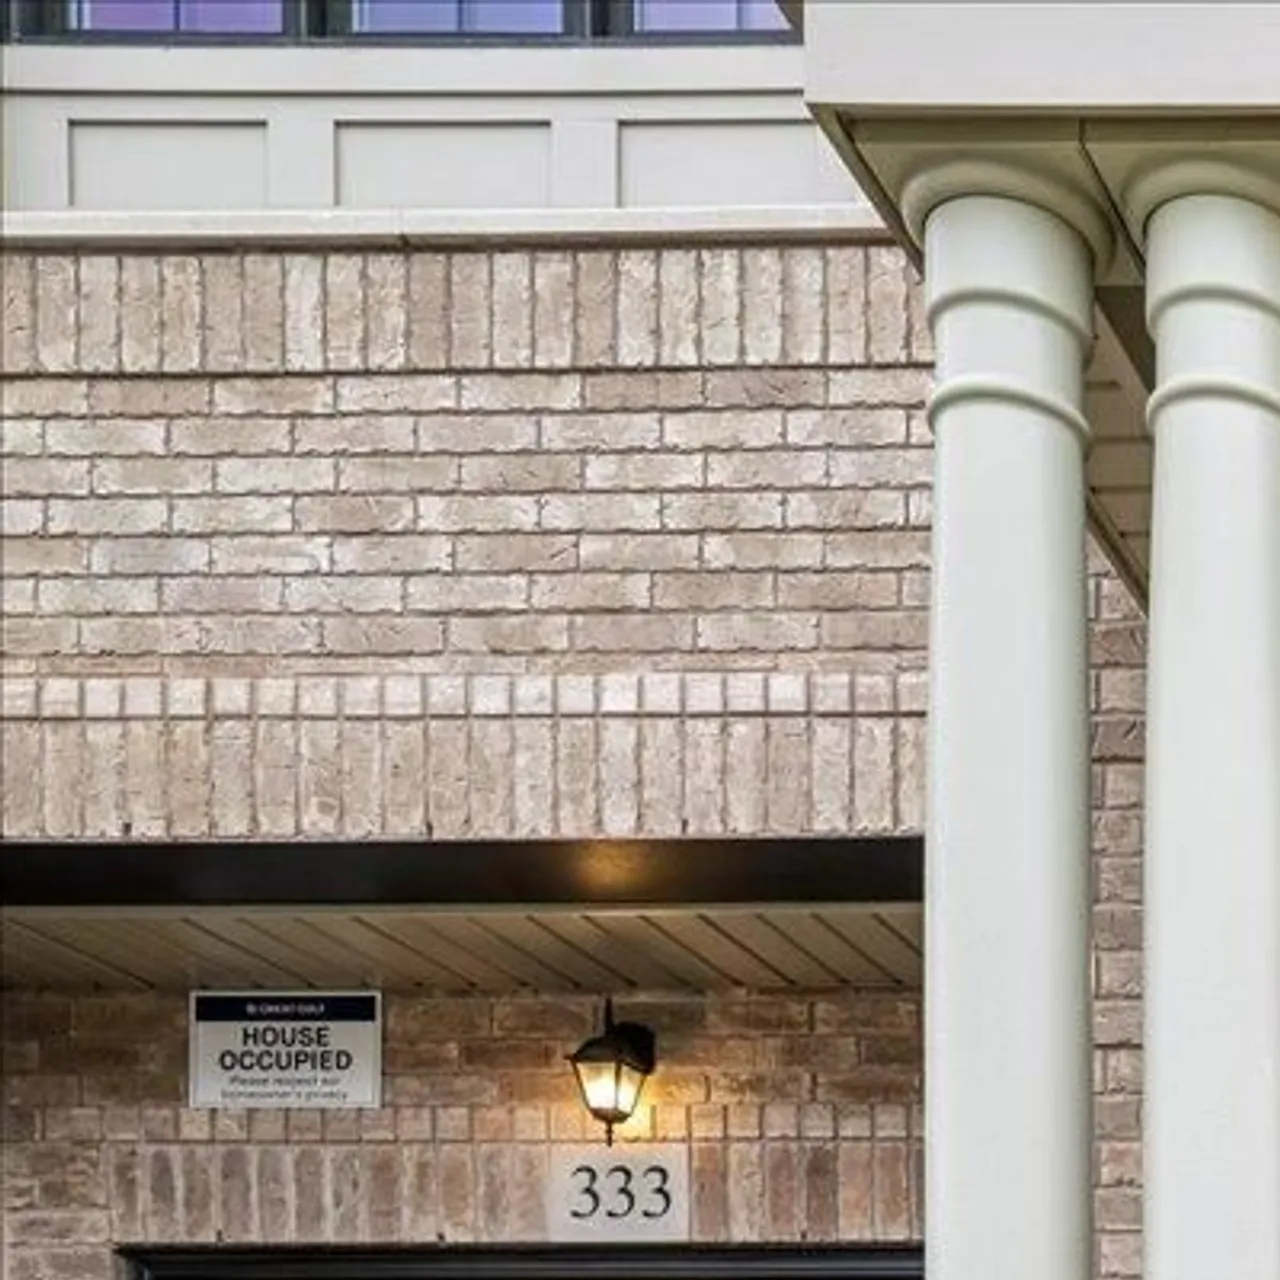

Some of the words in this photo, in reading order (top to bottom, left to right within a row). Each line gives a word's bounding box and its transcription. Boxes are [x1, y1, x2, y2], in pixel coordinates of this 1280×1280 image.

[242, 1027, 331, 1047] HOUSE
[219, 1050, 353, 1071] OCCUPIED
[569, 1164, 672, 1219] 333
